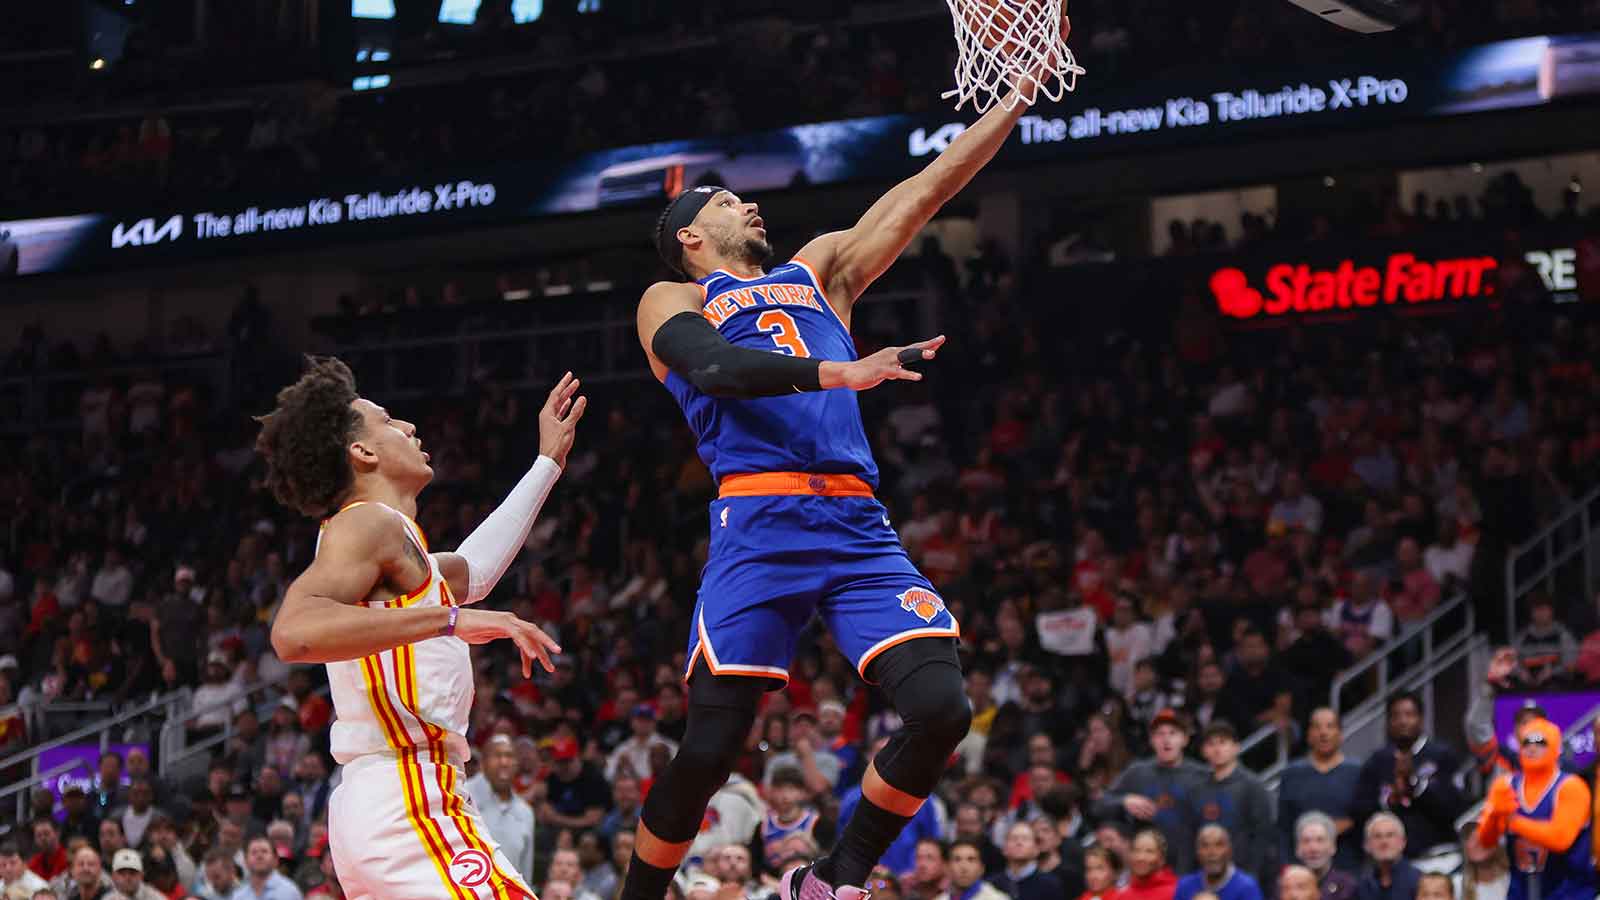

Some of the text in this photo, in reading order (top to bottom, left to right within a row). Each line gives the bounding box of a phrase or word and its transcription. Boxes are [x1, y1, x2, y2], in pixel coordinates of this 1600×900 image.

[1018, 76, 1408, 145] The all-new Kia Telluride X-Pro
[111, 214, 183, 249] KIA
[193, 180, 496, 239] The all-new Kia Telluride X-Pro
[703, 284, 823, 329] NEW YORK
[1263, 260, 1380, 315] State
[756, 308, 811, 358] 3
